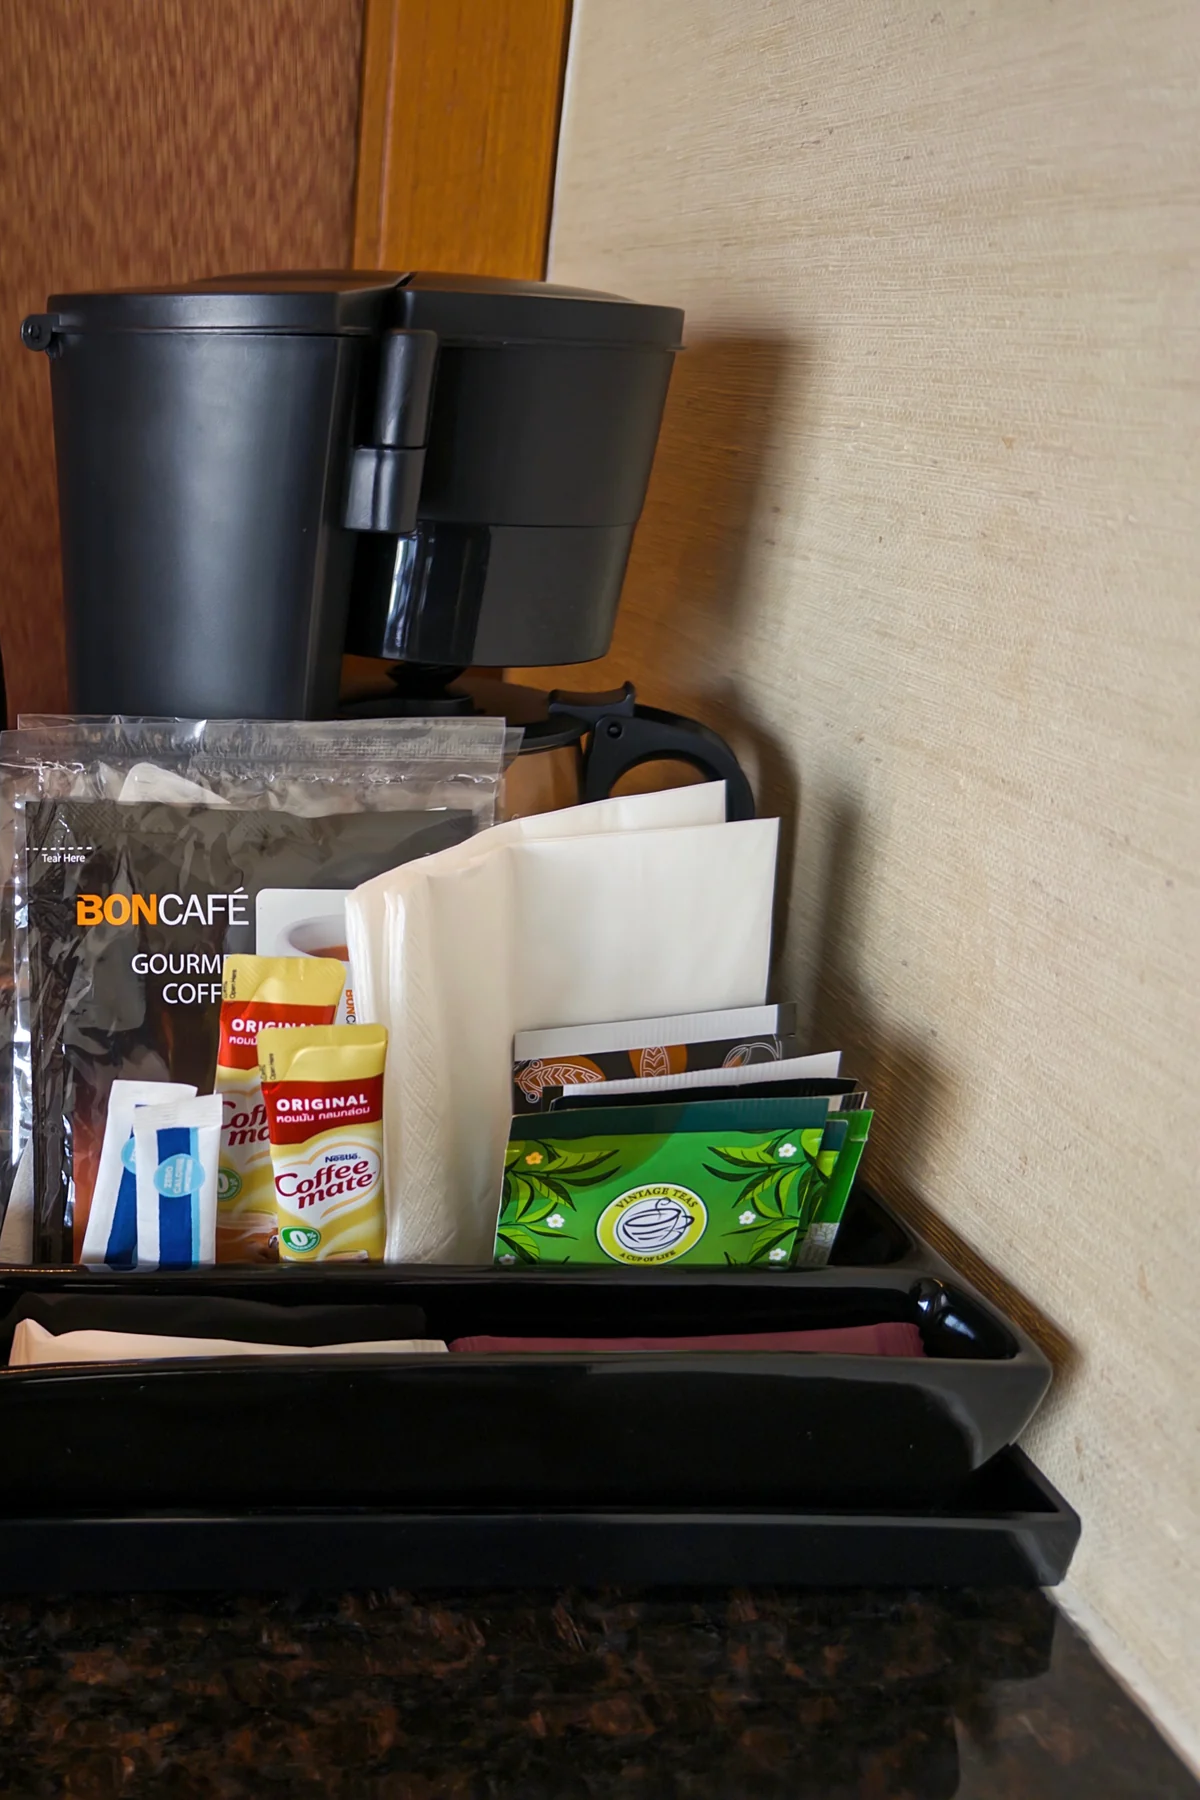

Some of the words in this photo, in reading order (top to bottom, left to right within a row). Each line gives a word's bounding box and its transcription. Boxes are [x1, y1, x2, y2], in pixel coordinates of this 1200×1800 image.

[41, 852, 61, 864] Tear
[63, 853, 86, 864] Here
[76, 886, 250, 926] BONCAFÉ
[131, 953, 230, 975] GOURM
[162, 983, 222, 1004] COFF
[276, 1093, 368, 1112] ORIGINAL
[228, 1126, 270, 1147] ma
[274, 1160, 370, 1197] Coffee
[298, 1173, 373, 1210] mate
[615, 1187, 669, 1210] VINTAGE
[672, 1189, 699, 1209] TEAS
[626, 1254, 643, 1262] CUP
[656, 1249, 677, 1261] LIFE
